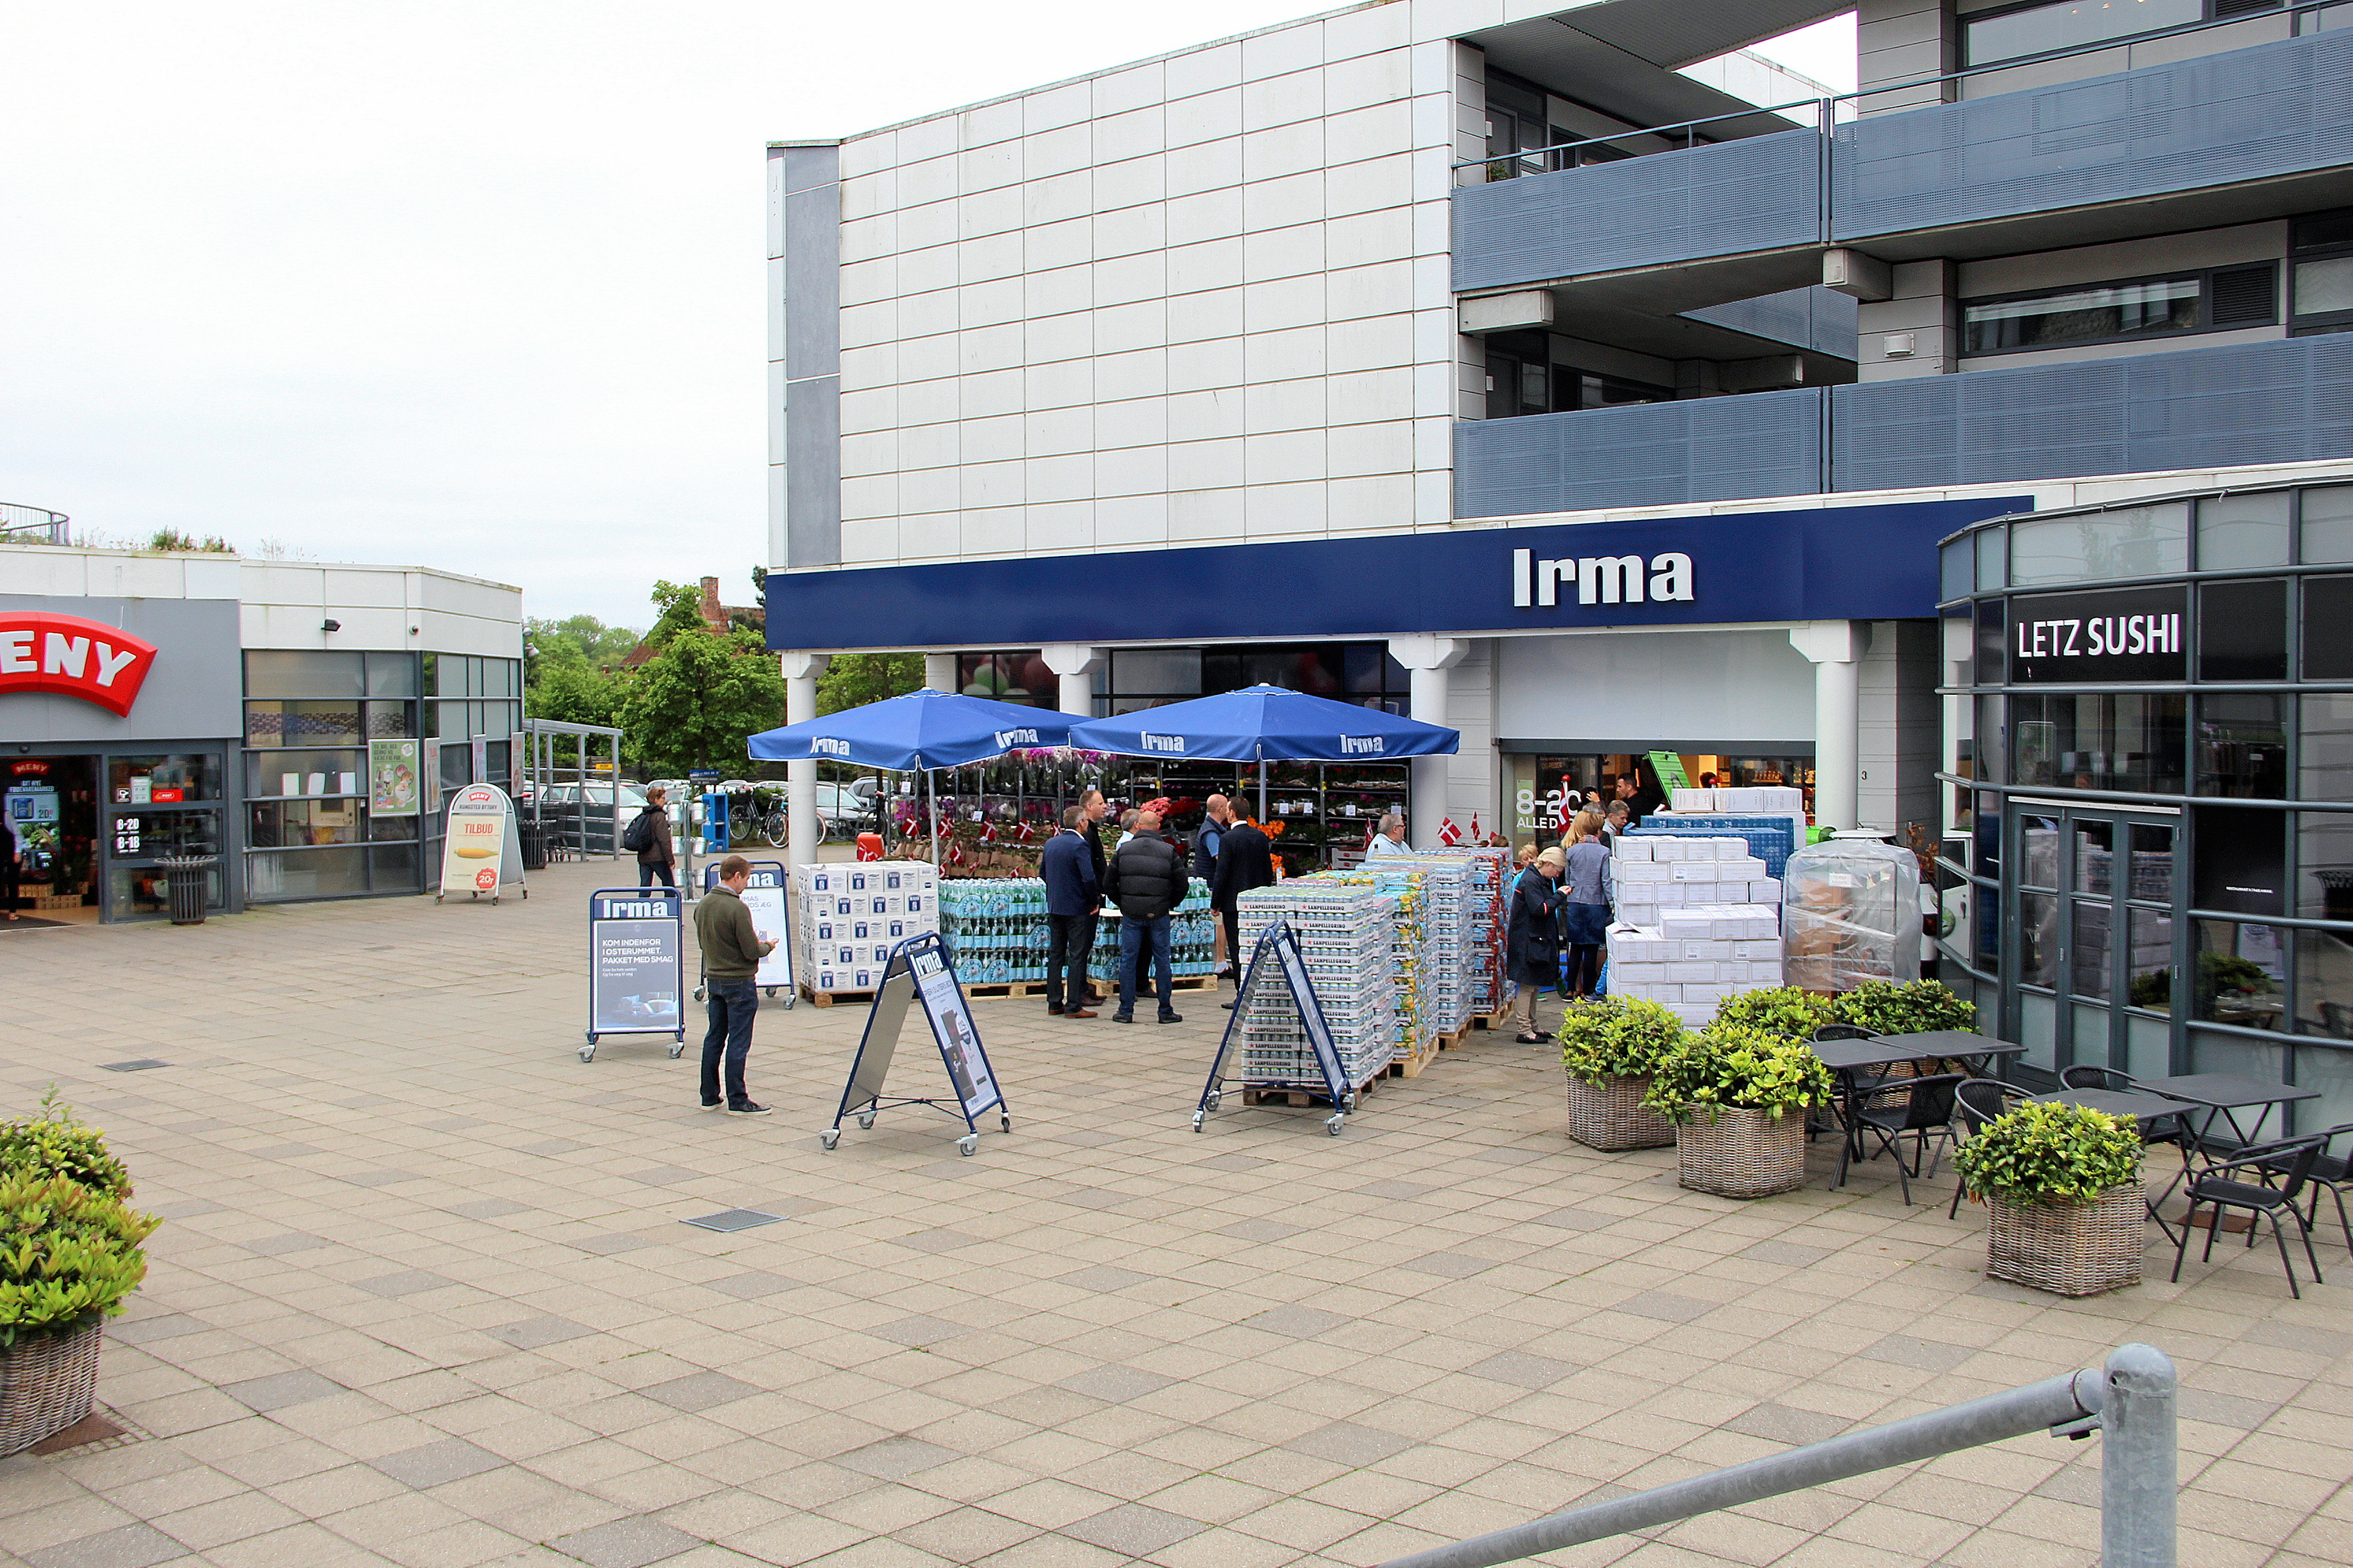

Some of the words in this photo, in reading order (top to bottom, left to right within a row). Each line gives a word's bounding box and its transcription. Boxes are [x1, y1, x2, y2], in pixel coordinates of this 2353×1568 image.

[1513, 548, 1694, 607] Irma
[2018, 619, 2081, 658] LETZ
[2087, 613, 2180, 656] SUSHI
[0, 630, 137, 687] ENY
[810, 736, 851, 756] Irma
[995, 727, 1039, 749] Irma
[1140, 730, 1186, 752] Irma
[1340, 734, 1384, 754] Irma
[1861, 770, 1867, 780] 3
[116, 818, 140, 831] 8-20
[464, 824, 493, 834] TILBUD
[1516, 817, 1547, 829] ALLE
[116, 836, 140, 849] 8-18
[603, 899, 668, 918] Irma
[621, 938, 661, 947] INDENFOR
[910, 950, 944, 977] Irma
